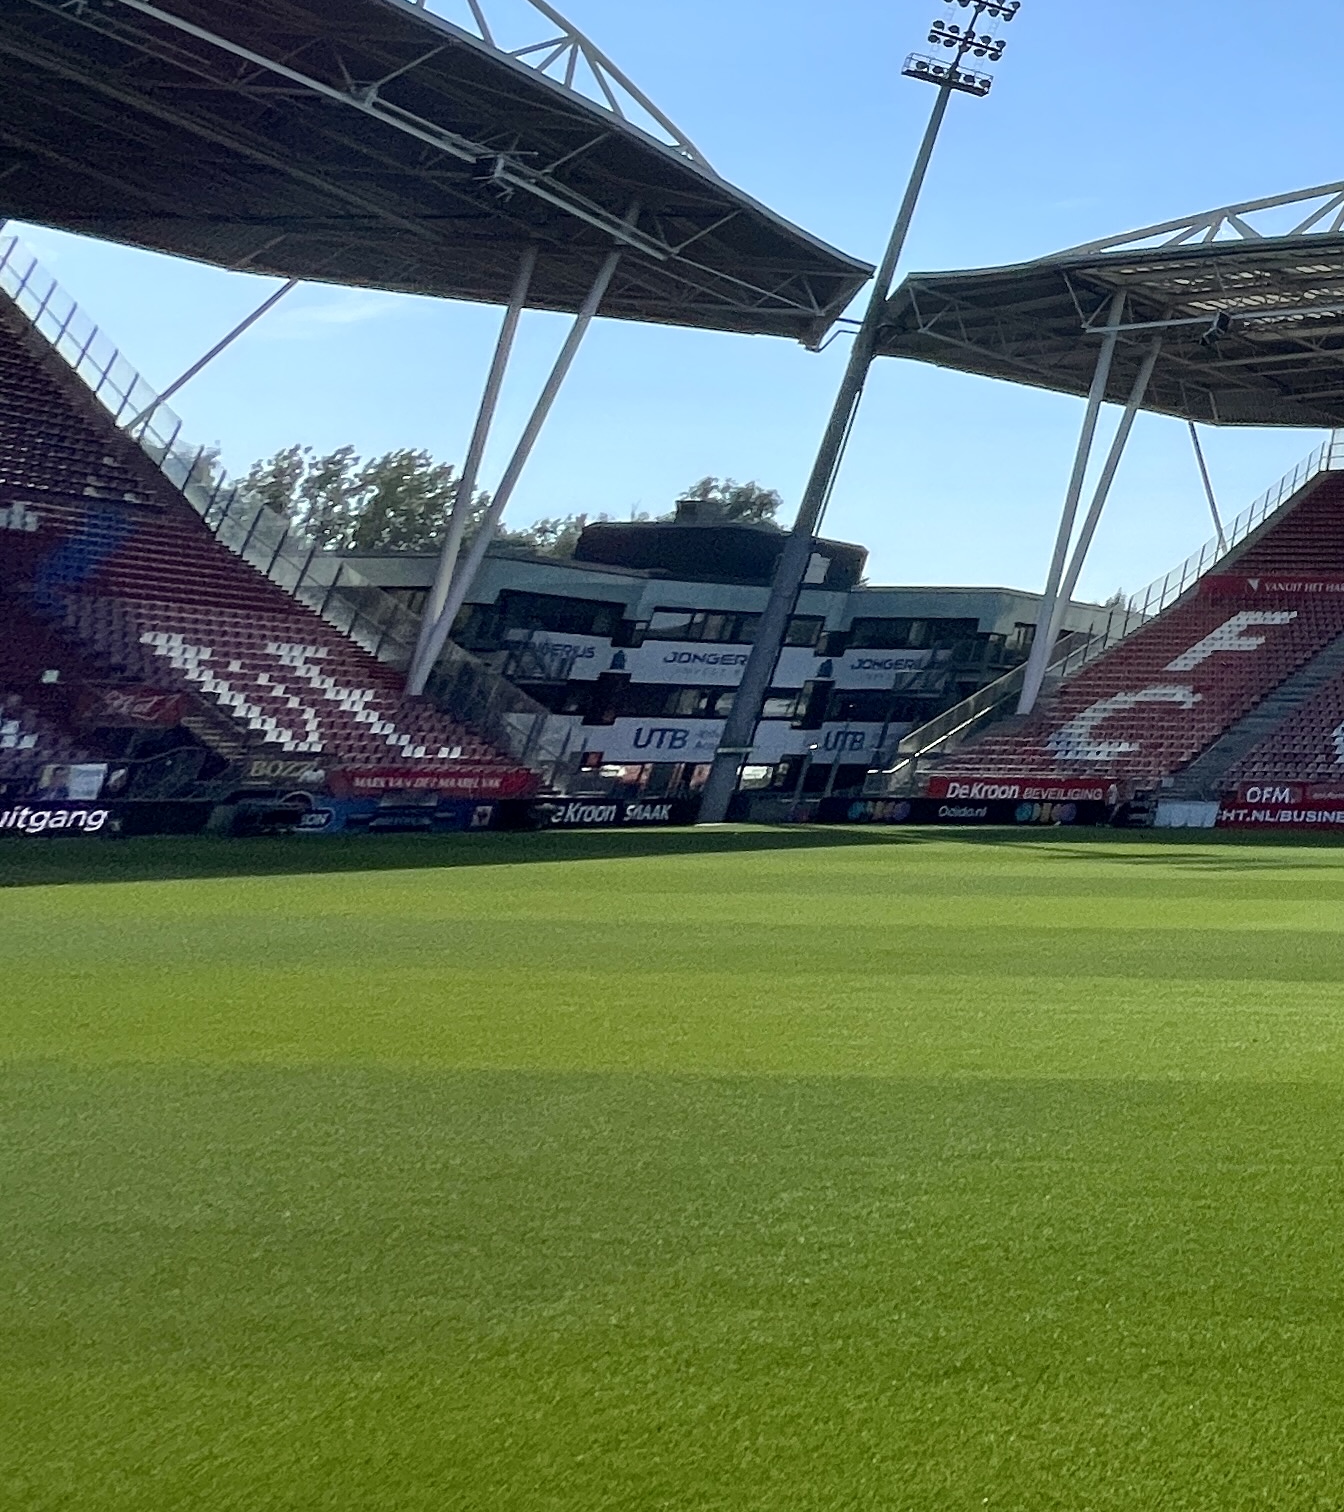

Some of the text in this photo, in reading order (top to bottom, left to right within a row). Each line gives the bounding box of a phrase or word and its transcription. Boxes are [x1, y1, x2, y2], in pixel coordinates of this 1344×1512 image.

[1304, 583, 1323, 592] HET
[663, 650, 749, 666] JONGER
[632, 727, 690, 750] UTB
[823, 731, 866, 751] UTB
[1022, 787, 1103, 800] BEVEILIGING
[551, 801, 617, 823] eKroon
